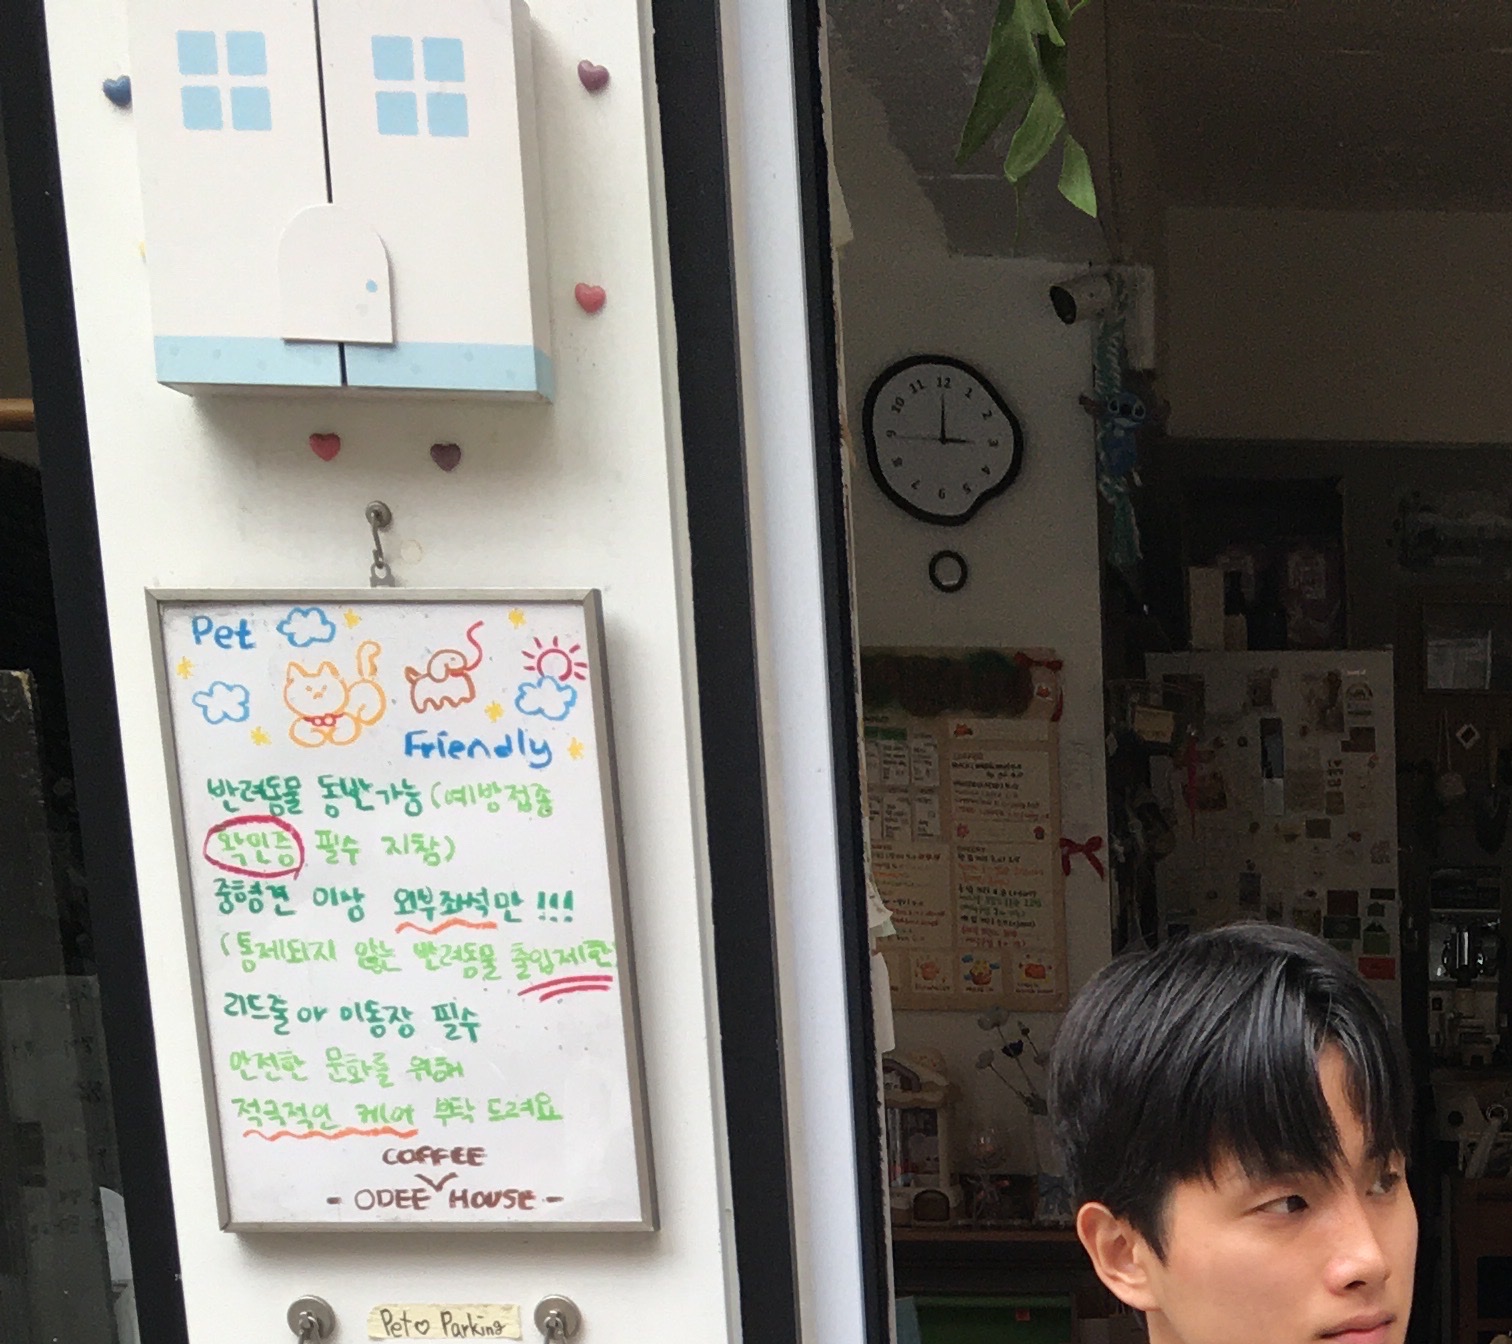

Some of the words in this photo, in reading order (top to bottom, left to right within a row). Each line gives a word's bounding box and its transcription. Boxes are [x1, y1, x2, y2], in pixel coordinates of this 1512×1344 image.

[910, 380, 925, 394] 11
[937, 377, 951, 389] 12
[891, 396, 906, 414] 10
[192, 615, 258, 650] Pet
[403, 729, 553, 770] Friendly
[207, 775, 303, 817] 반려동물
[314, 829, 361, 866] 필수
[312, 886, 366, 923] 이상
[354, 936, 403, 975] 않는
[412, 940, 502, 981] 반려동물
[223, 991, 291, 1036] 리드줄
[296, 1005, 329, 1024] or
[339, 999, 416, 1039] 이동장
[431, 1002, 482, 1043] 필수
[229, 1049, 309, 1082] 안전한
[325, 1046, 395, 1088] 문화를
[230, 1097, 343, 1131] 적극적인
[354, 1102, 416, 1126] 케어
[432, 1096, 476, 1127] 부탁
[381, 1145, 488, 1167] COFFEE
[354, 1187, 432, 1211] ODEE
[449, 1187, 537, 1211] HOUSE
[380, 1307, 410, 1338] Pet
[439, 1310, 508, 1338] Parking
